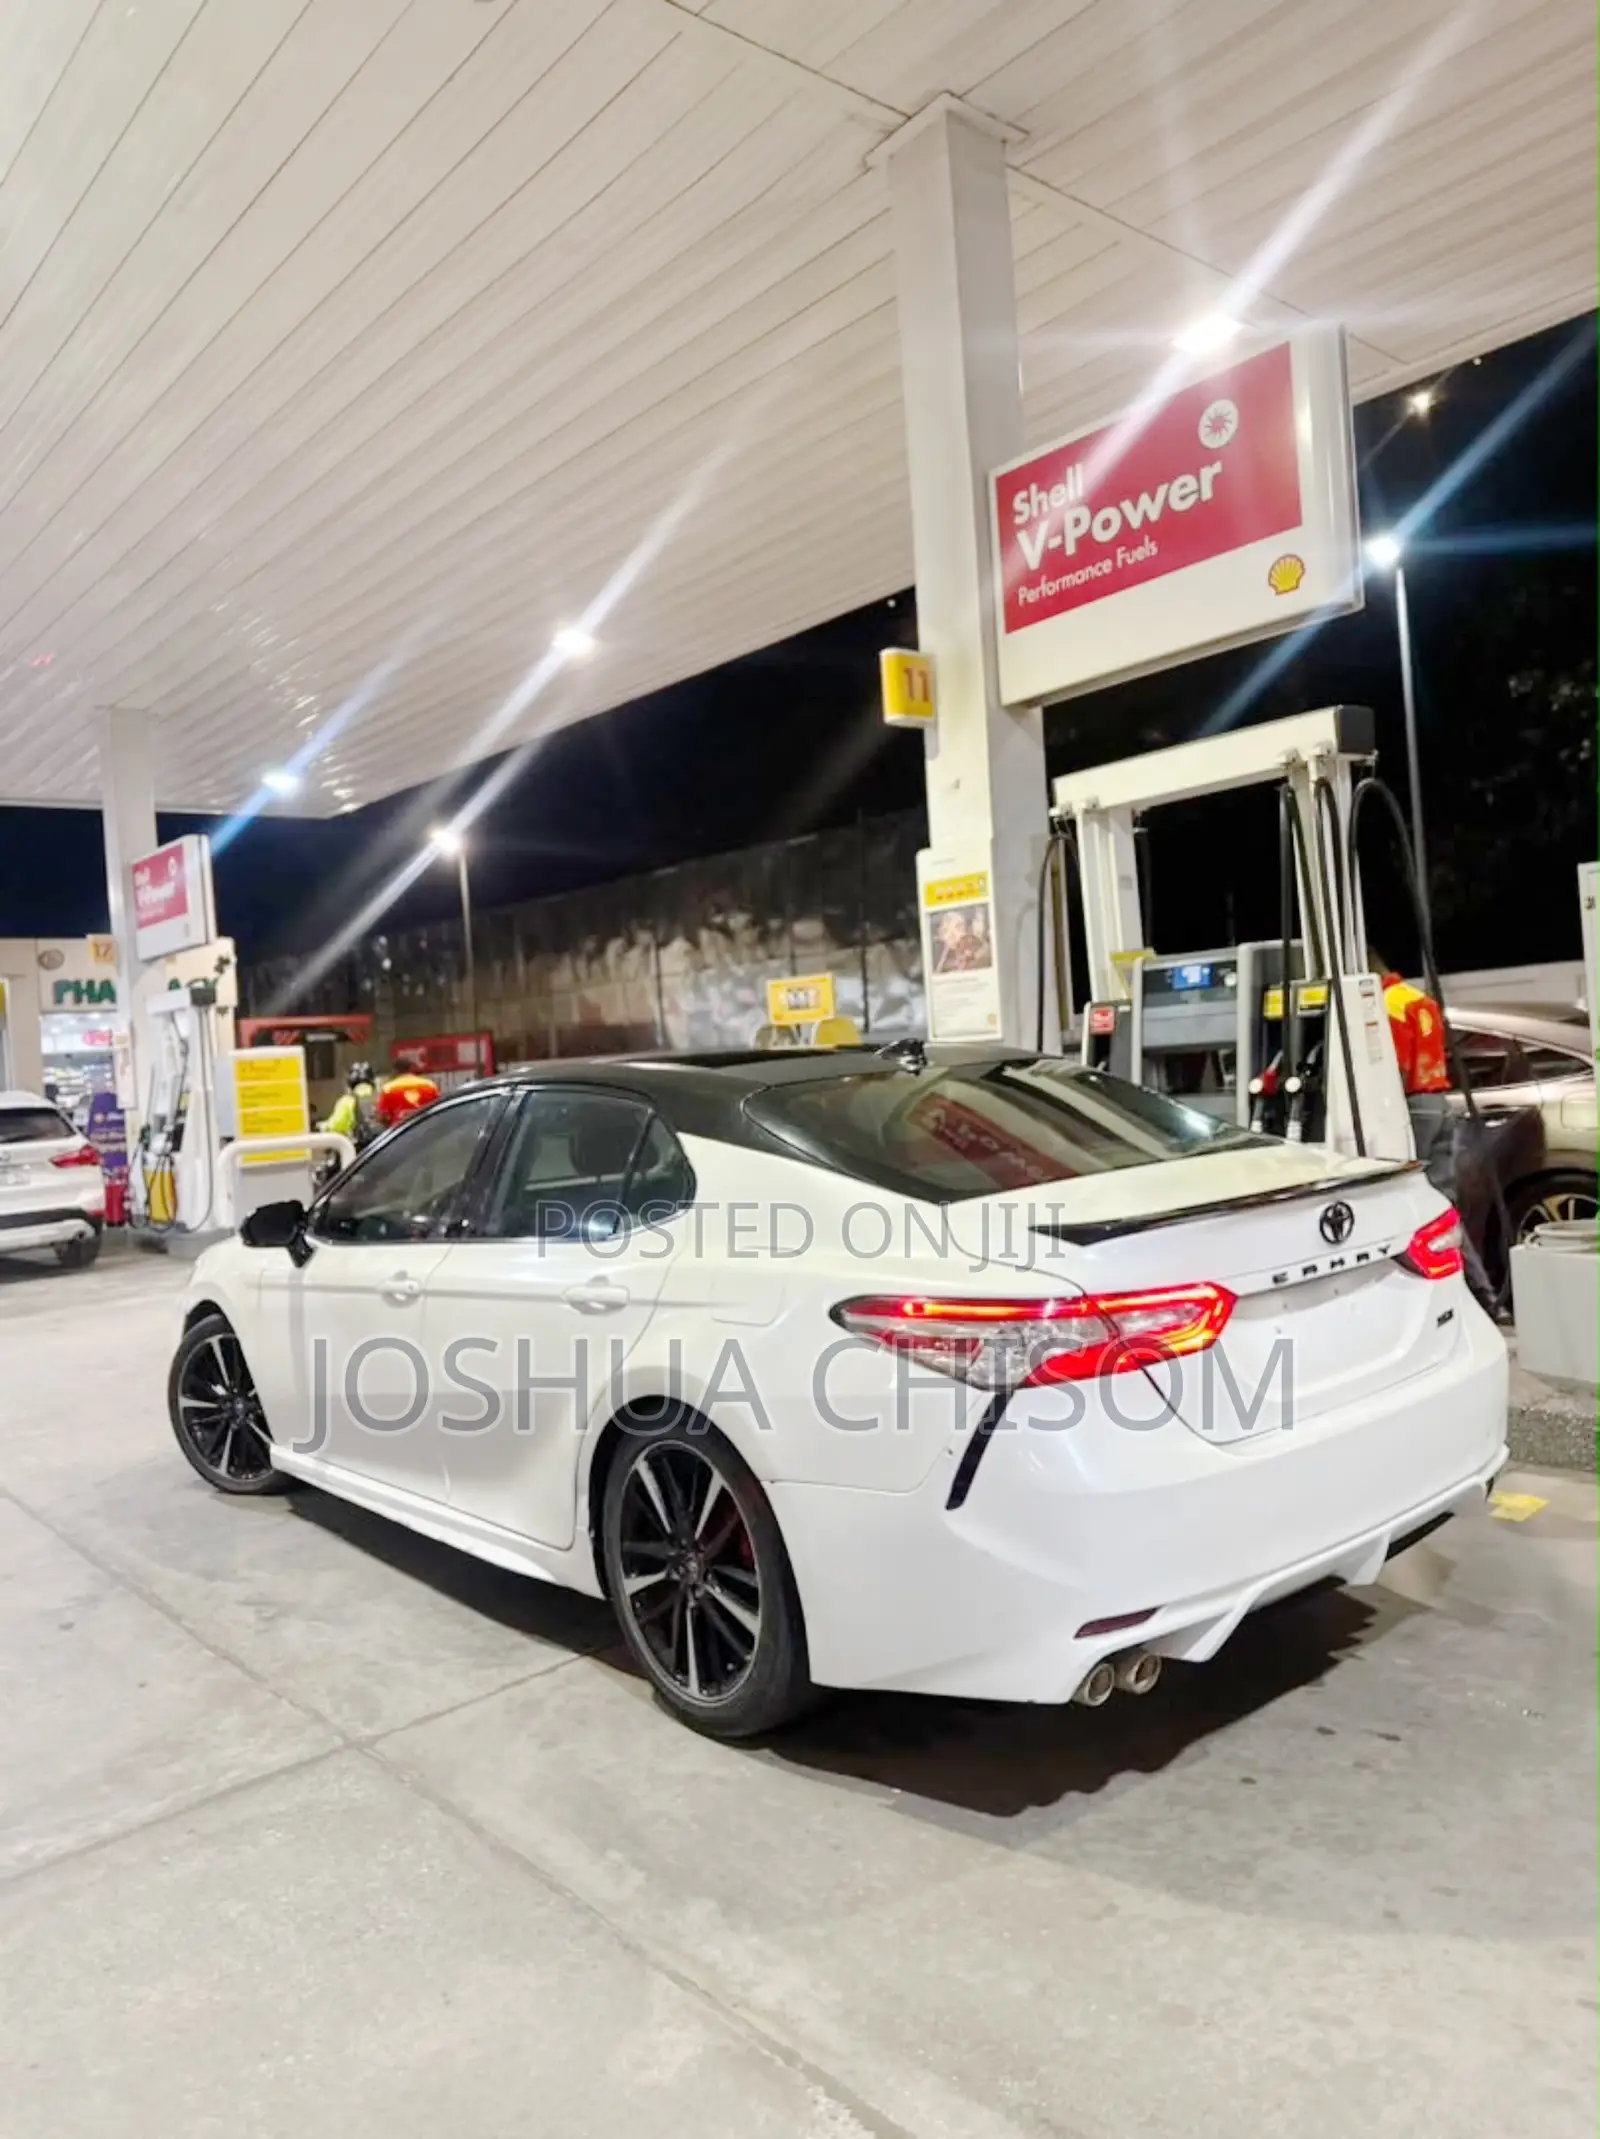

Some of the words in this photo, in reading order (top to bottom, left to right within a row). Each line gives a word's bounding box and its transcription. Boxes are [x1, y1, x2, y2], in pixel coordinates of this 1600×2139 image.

[1013, 463, 1084, 525] Shell
[1017, 461, 1222, 571] V-Power
[1018, 557, 1113, 606] Performance
[1116, 535, 1159, 569] Fuels
[903, 666, 929, 703] 11
